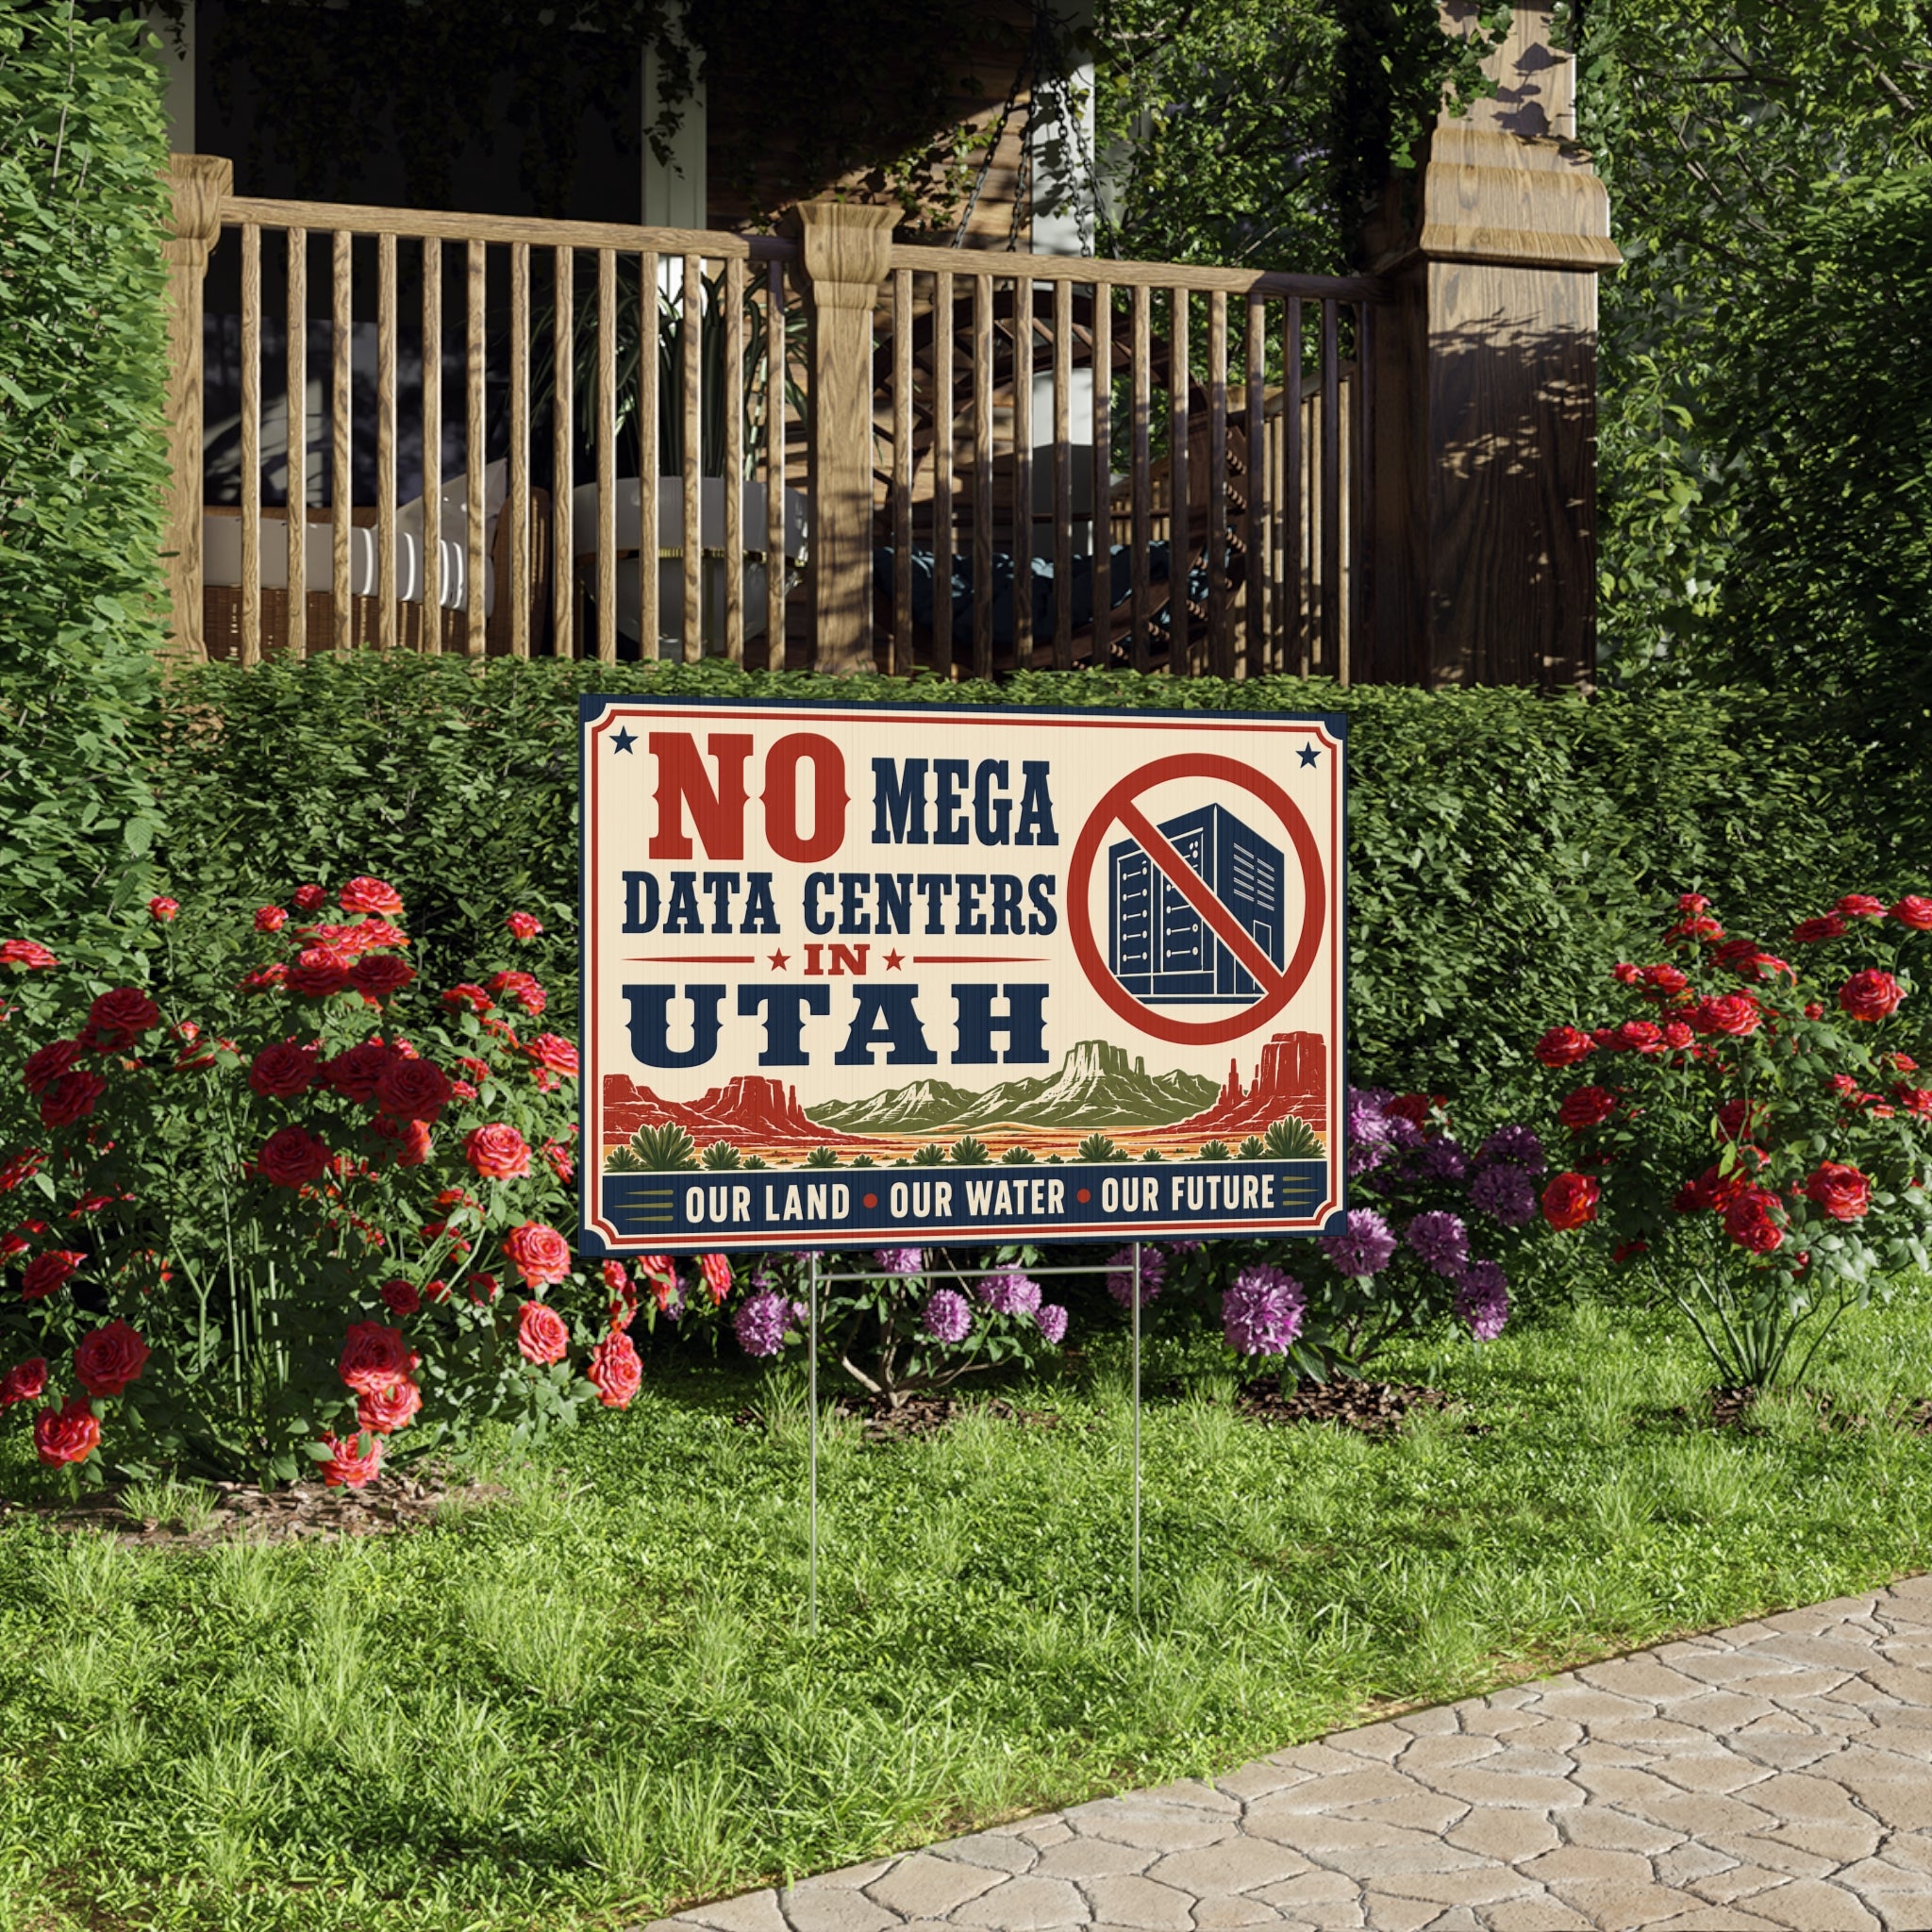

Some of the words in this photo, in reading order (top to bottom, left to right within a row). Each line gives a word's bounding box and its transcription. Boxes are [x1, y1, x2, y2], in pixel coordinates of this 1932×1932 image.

[649, 732, 851, 863] NO
[871, 758, 1059, 846] MEGA
[622, 872, 781, 934] DATA
[802, 872, 1058, 936] CENTERS
[804, 943, 870, 975] IN
[622, 983, 1049, 1068] UTAH
[685, 1185, 752, 1224] OUR
[765, 1183, 851, 1223] LAND
[890, 1180, 957, 1218] OUR
[965, 1178, 1065, 1217] WATER
[1101, 1176, 1162, 1213] OUR
[1170, 1174, 1275, 1211] FUTURE
